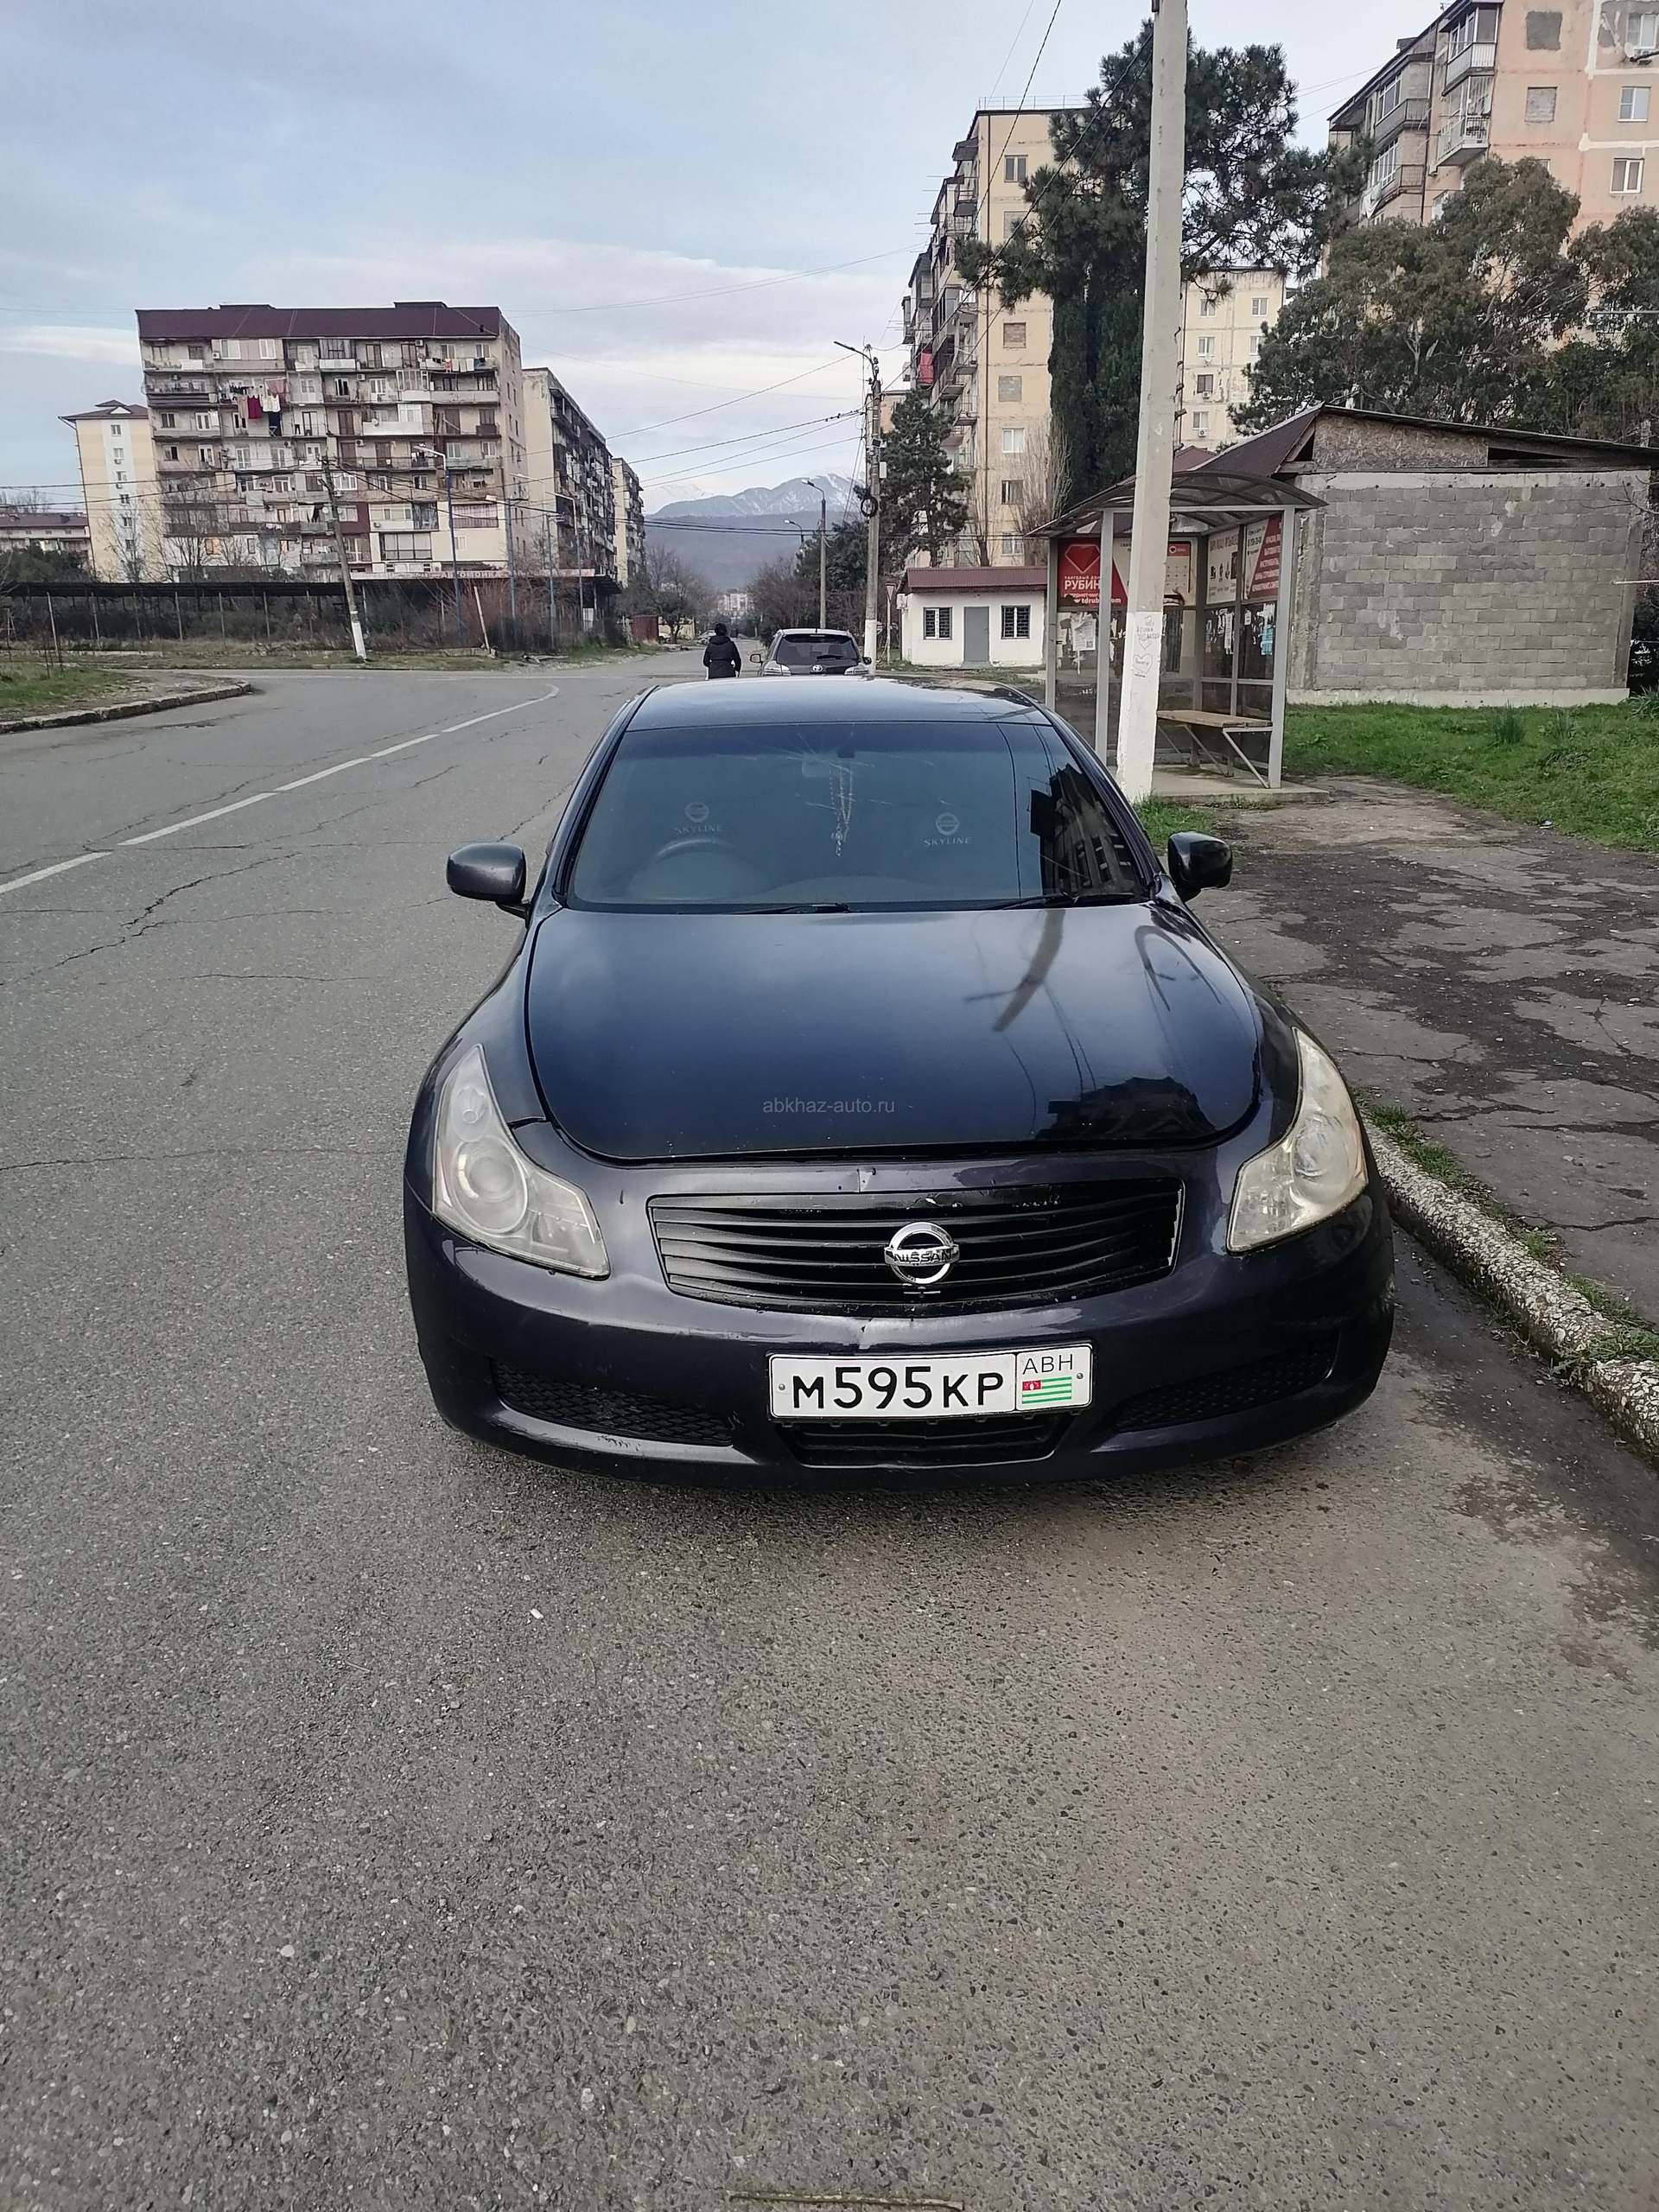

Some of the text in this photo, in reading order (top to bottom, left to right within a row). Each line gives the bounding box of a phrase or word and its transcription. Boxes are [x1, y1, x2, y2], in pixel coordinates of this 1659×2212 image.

[1065, 580, 1101, 590] РУБИН
[924, 836, 976, 847] SKYLINE
[894, 1248, 952, 1263] NISSAN
[1022, 1353, 1074, 1375] ABH
[792, 1366, 1004, 1409] М595КР
